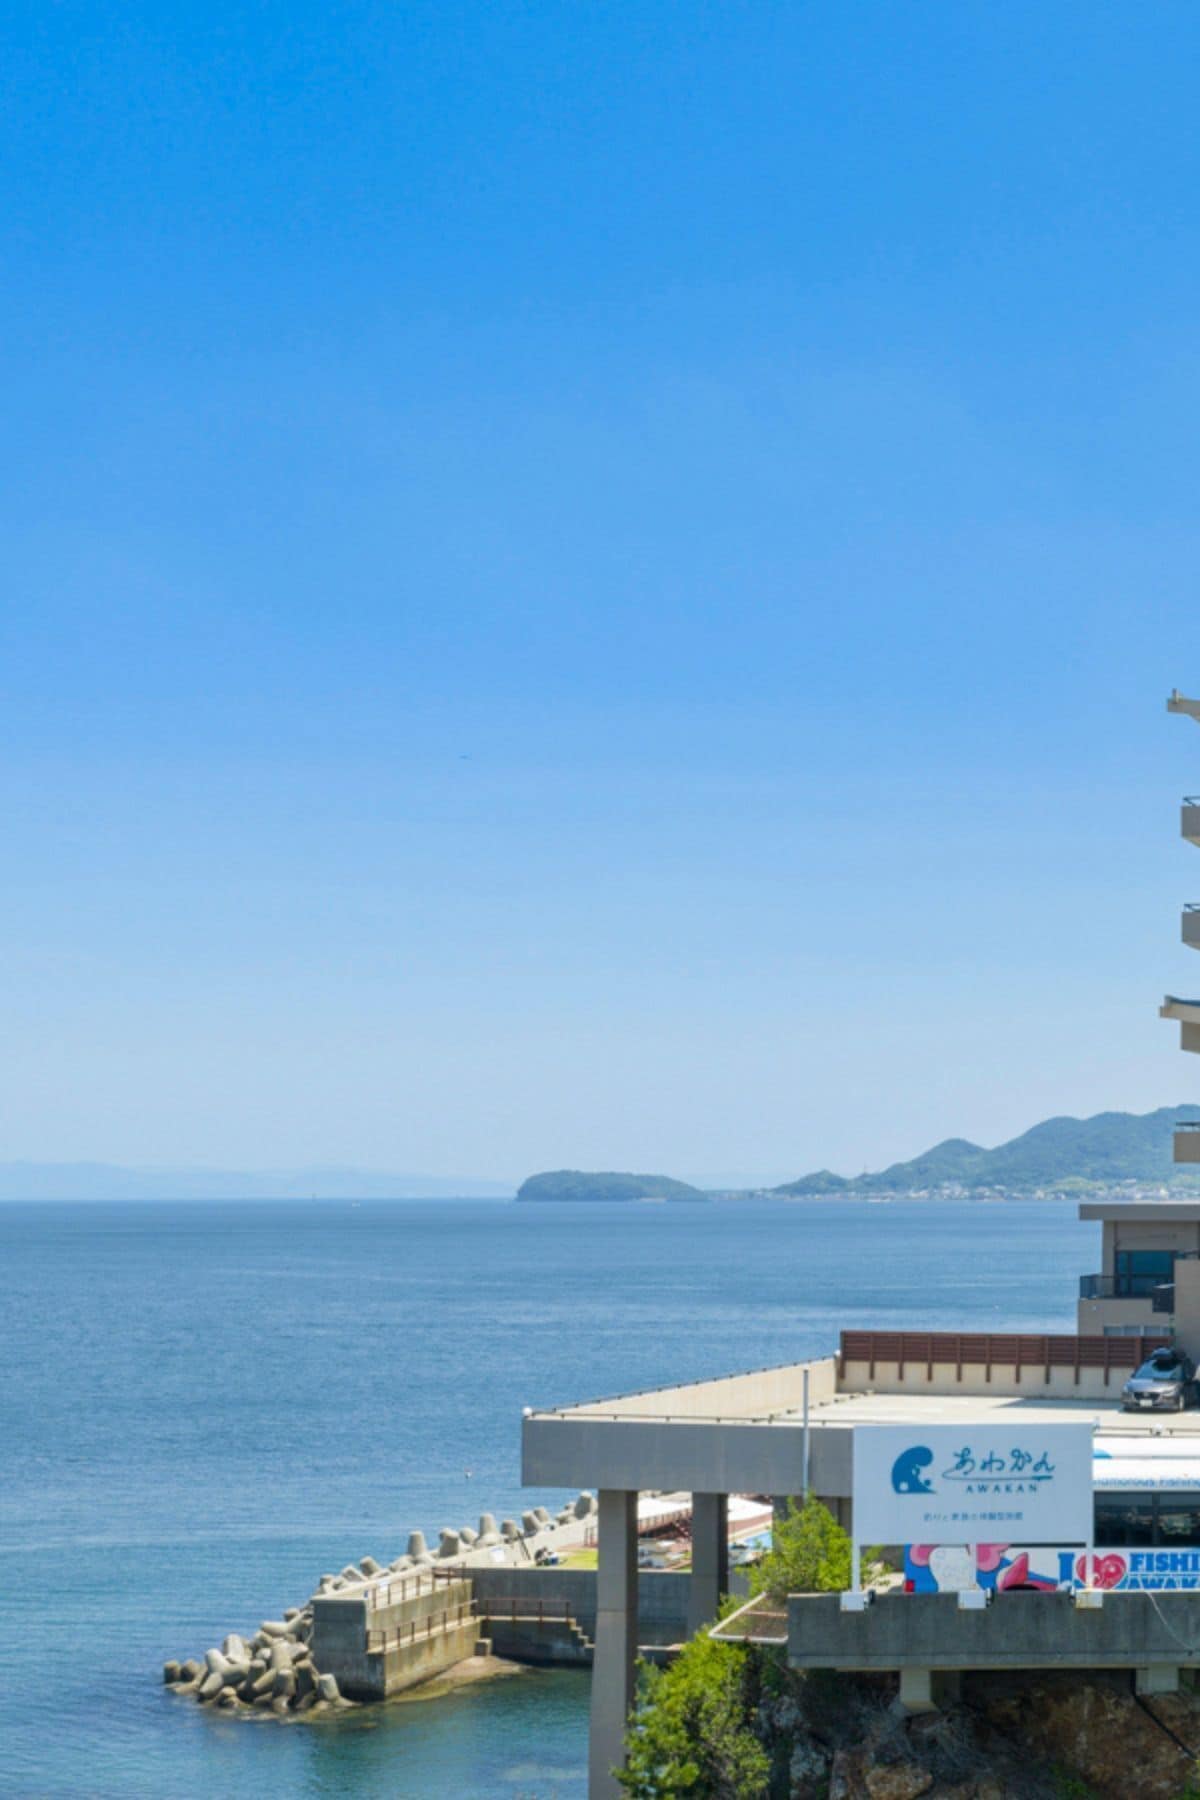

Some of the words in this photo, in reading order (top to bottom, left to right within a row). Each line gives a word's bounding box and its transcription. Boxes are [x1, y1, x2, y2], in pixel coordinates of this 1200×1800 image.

[943, 1447, 1055, 1479] あわかん
[966, 1483, 1037, 1494] AWAKAN
